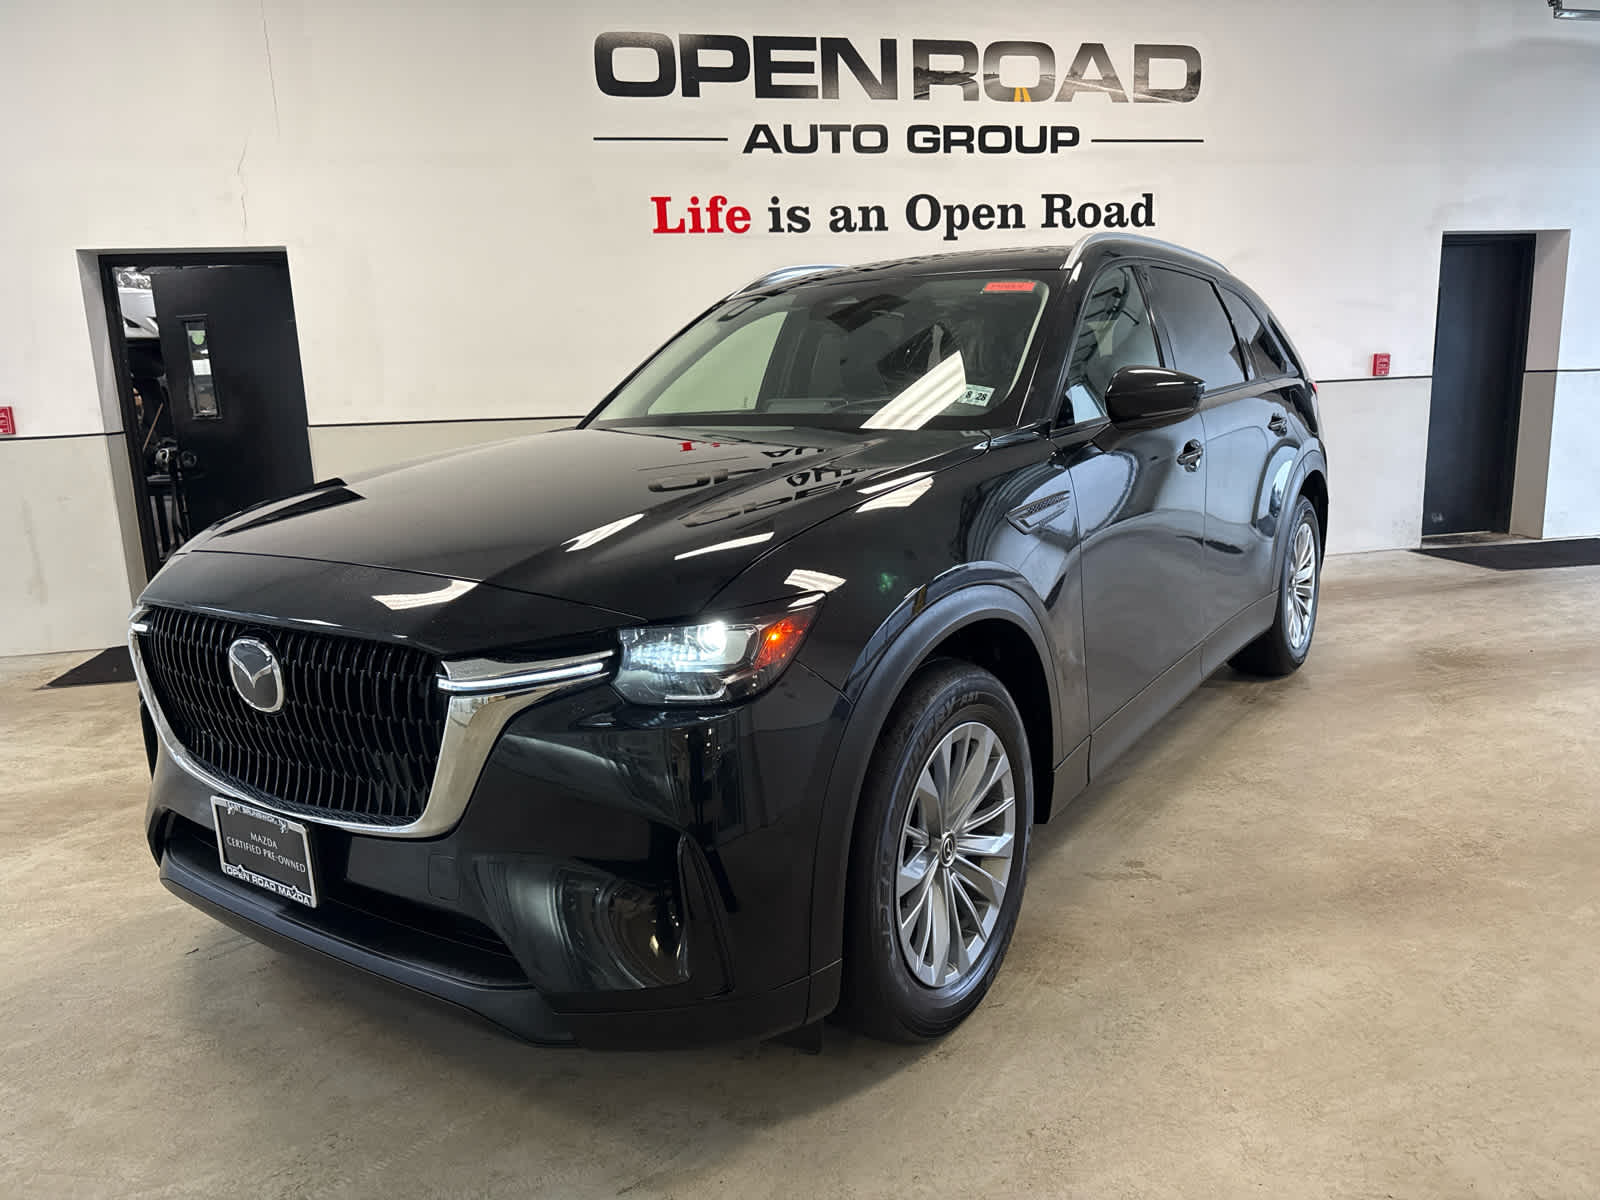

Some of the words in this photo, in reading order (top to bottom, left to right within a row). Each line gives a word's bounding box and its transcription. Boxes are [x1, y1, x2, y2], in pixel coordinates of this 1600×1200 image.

[594, 31, 898, 101] OPEN
[912, 39, 1202, 103] ROAD
[742, 124, 888, 153] AUTO
[906, 124, 1080, 154] GROUP
[650, 194, 751, 234] Life
[767, 196, 811, 233] is
[829, 205, 888, 233] an
[905, 194, 1026, 241] Open
[1040, 193, 1156, 230] Road
[226, 836, 262, 855] CERTIFIED
[263, 848, 306, 873] PRE-OWNED
[250, 832, 278, 849] MAZDA
[226, 866, 251, 882] OPEN
[251, 877, 276, 892] ROAD
[278, 886, 310, 906] MAZDA
